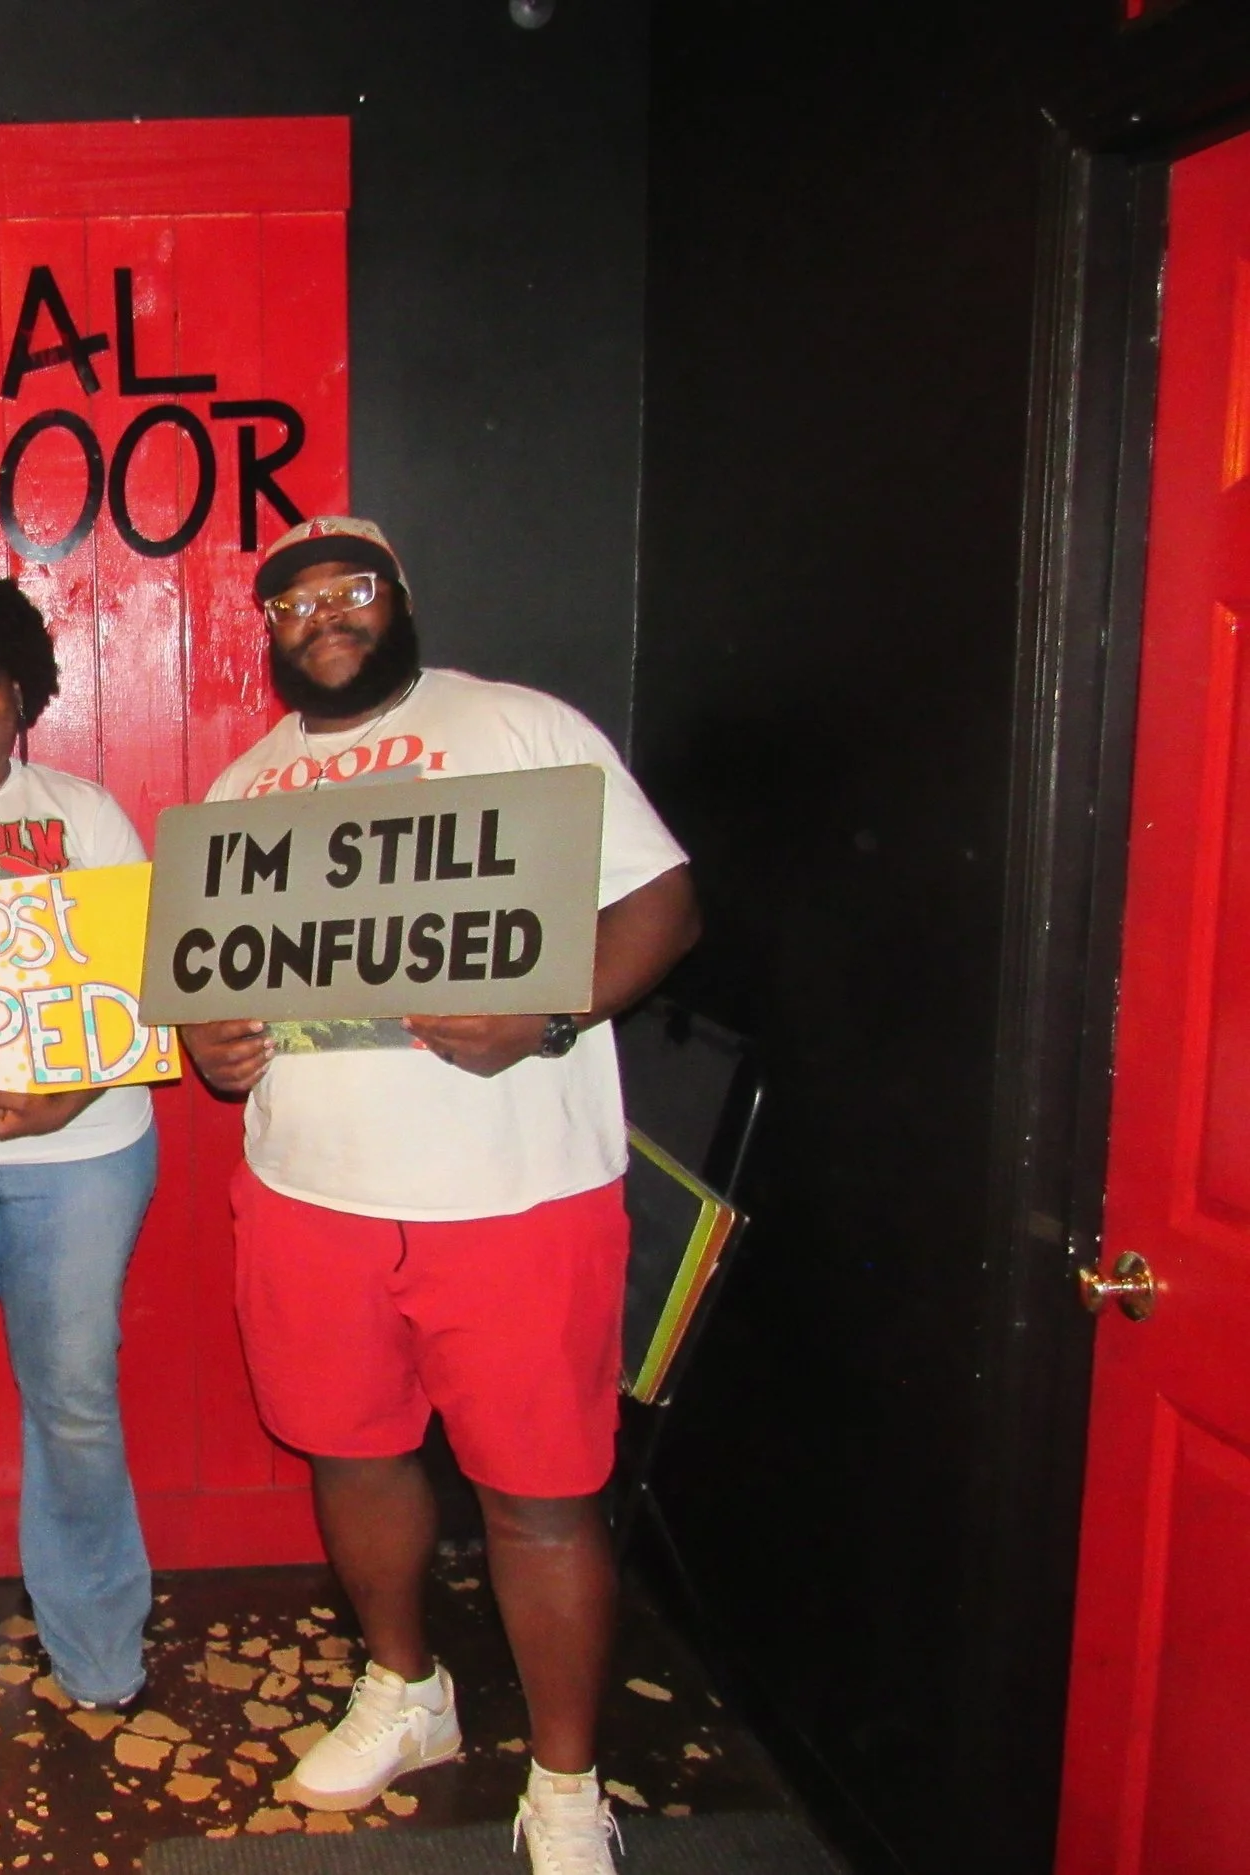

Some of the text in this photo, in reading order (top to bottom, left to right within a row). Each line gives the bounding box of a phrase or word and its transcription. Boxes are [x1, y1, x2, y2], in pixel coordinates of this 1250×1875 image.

[204, 809, 516, 898] I'M STILL
[172, 908, 543, 994] CONFUSED
